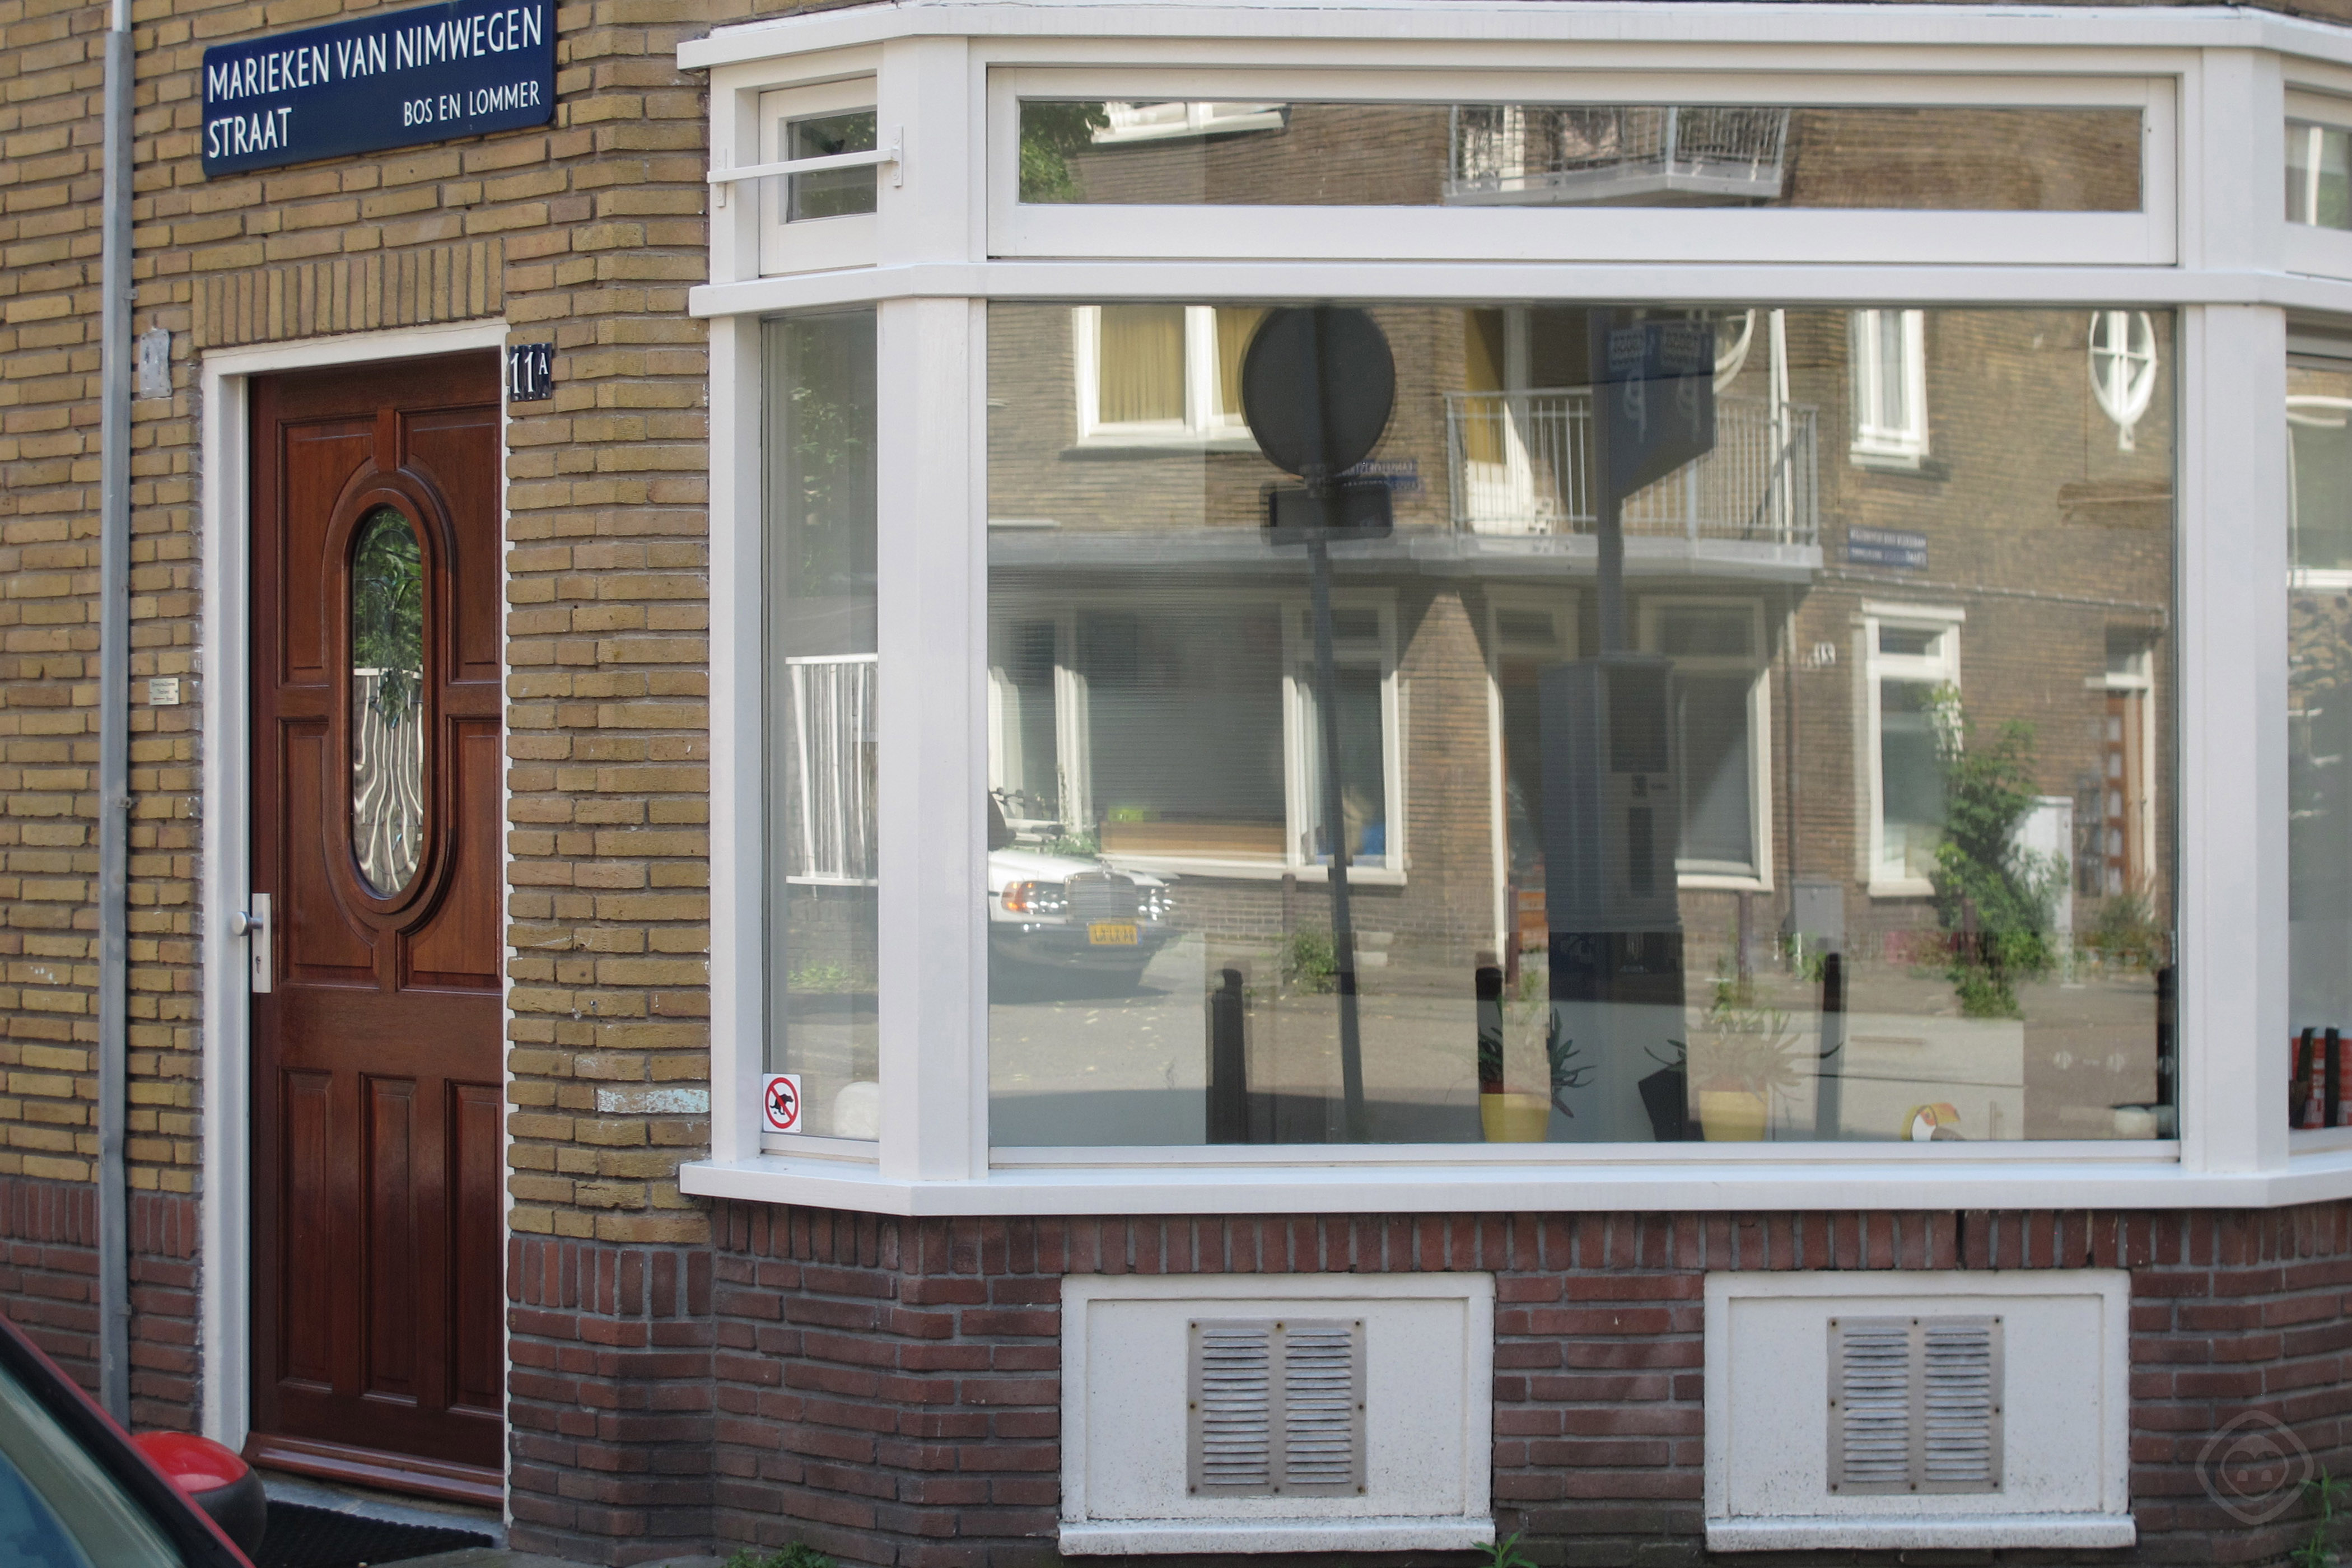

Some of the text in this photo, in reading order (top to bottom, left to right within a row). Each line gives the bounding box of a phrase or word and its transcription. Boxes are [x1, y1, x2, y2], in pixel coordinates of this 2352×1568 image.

[208, 4, 543, 103] MARIEKEN VAN NIMWEGEN
[403, 80, 541, 128] BOS EN LOMMER
[208, 107, 292, 158] STRAAT
